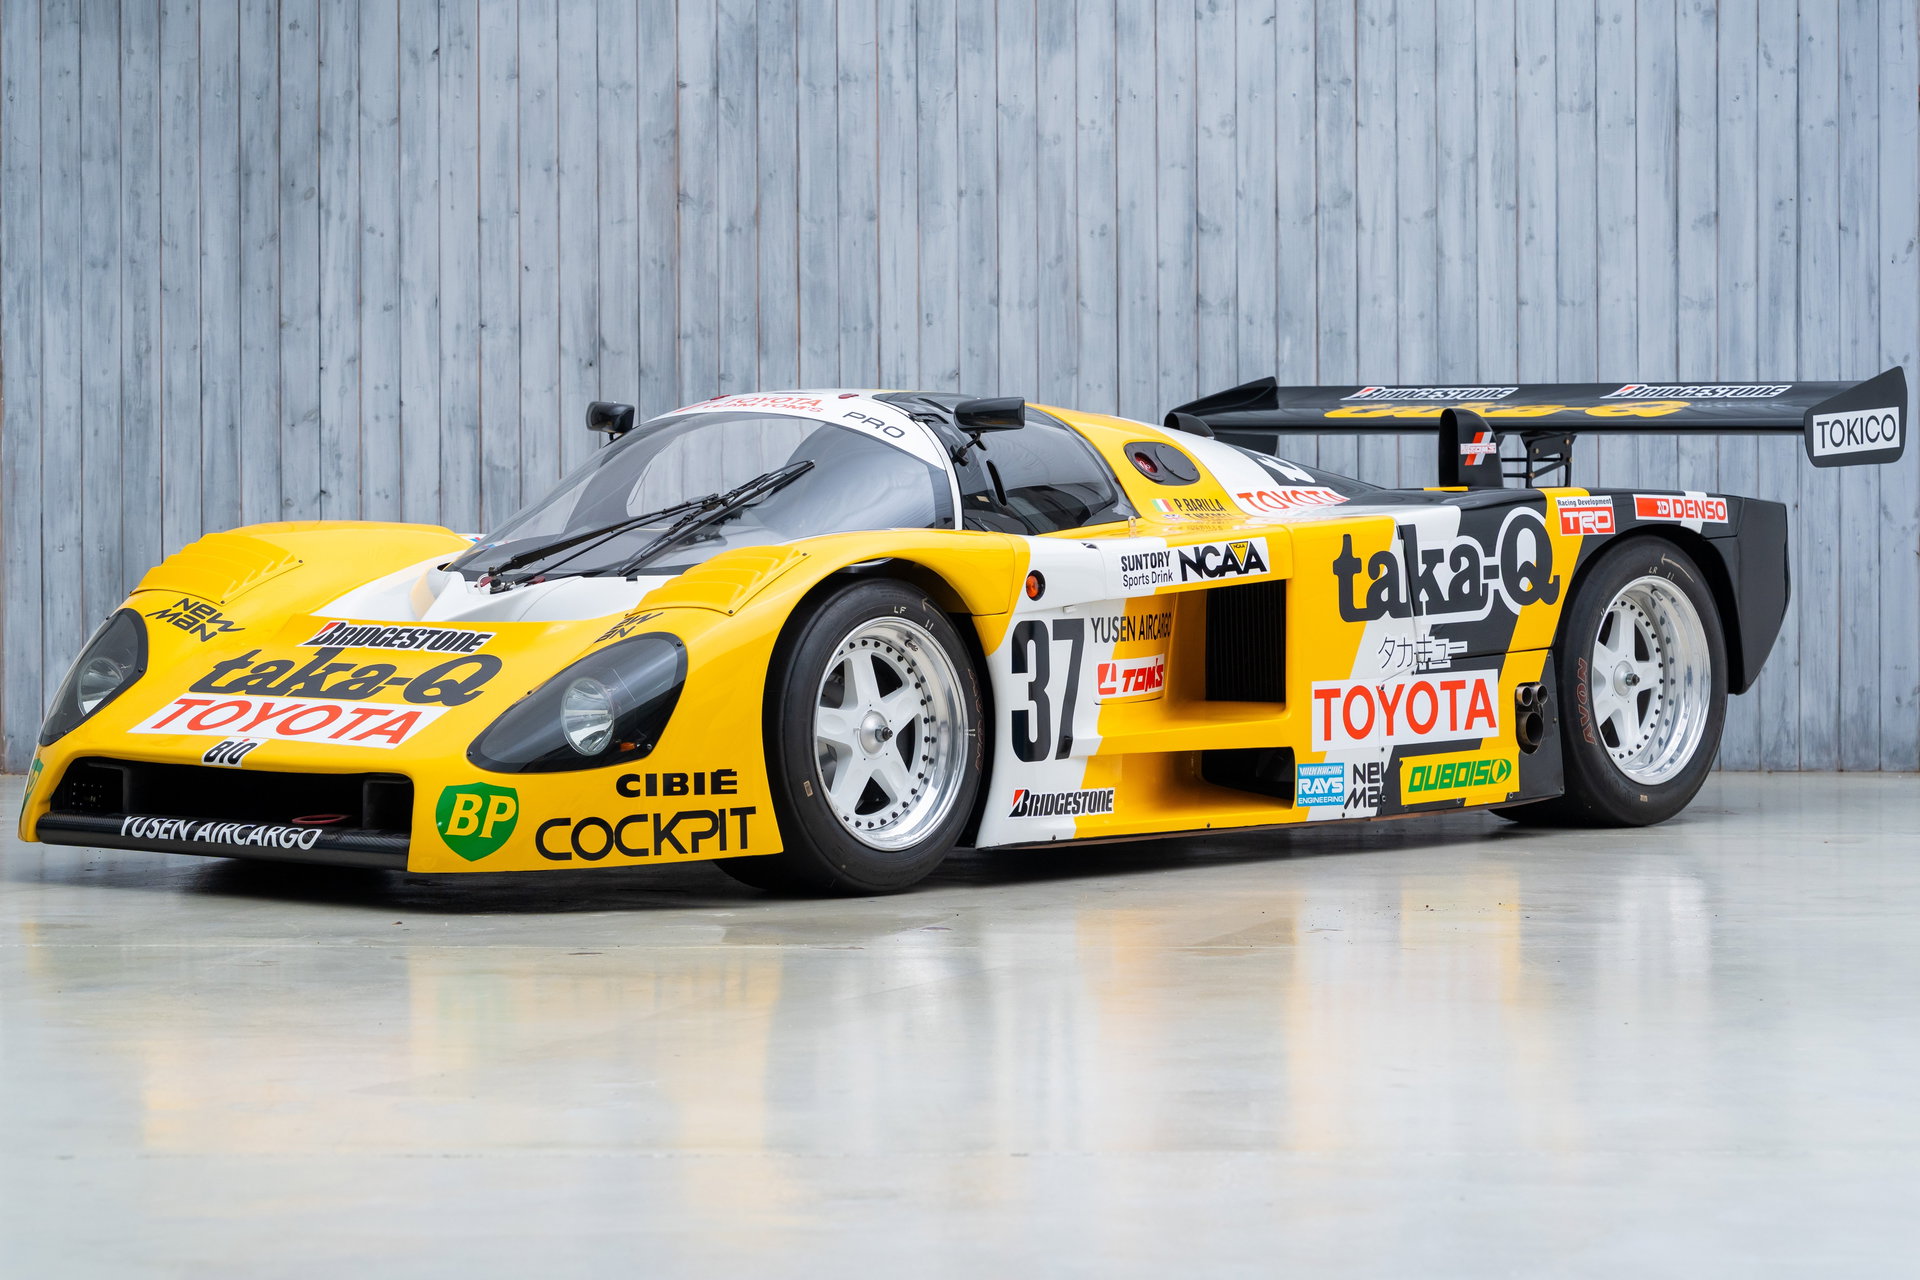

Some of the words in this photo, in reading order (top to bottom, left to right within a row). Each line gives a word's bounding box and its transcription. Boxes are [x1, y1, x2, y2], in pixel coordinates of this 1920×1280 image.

[1342, 386, 1517, 400] BRIDGESTONE
[1602, 384, 1792, 399] BRIDGESTONE
[842, 411, 905, 439] PRO
[1816, 413, 1897, 449] TOKICO
[1236, 489, 1349, 513] TOYOTA
[1557, 499, 1577, 508] Racing
[1577, 497, 1612, 507] Development
[1672, 499, 1727, 521] DENSO
[1562, 510, 1612, 534] TRD
[1120, 550, 1171, 572] SUNTORY
[1177, 541, 1268, 582] NCAA
[1332, 513, 1561, 623] taka-Q
[1122, 570, 1150, 589] Sports
[1151, 569, 1174, 584] Drink
[893, 606, 907, 614] LF
[302, 621, 494, 653] BRIDGESTONE
[1090, 615, 1136, 644] YUSEN
[1138, 611, 1172, 641] AIRCARGO
[188, 647, 503, 706] taka-Q
[1011, 617, 1085, 763] 37
[1121, 657, 1164, 693] TOM'S
[1313, 678, 1498, 741] TOYOTA
[1576, 657, 1598, 746] AVON
[150, 699, 425, 745] TOYOTA
[1298, 777, 1344, 795] RAYS
[1298, 796, 1344, 805] ENGINEERING
[443, 791, 516, 840] BP
[1008, 788, 1114, 818] BRIDGESTONE
[120, 815, 199, 842] YUSEN
[193, 821, 323, 851] AIRCARGO
[534, 805, 757, 862] COCKPIT
